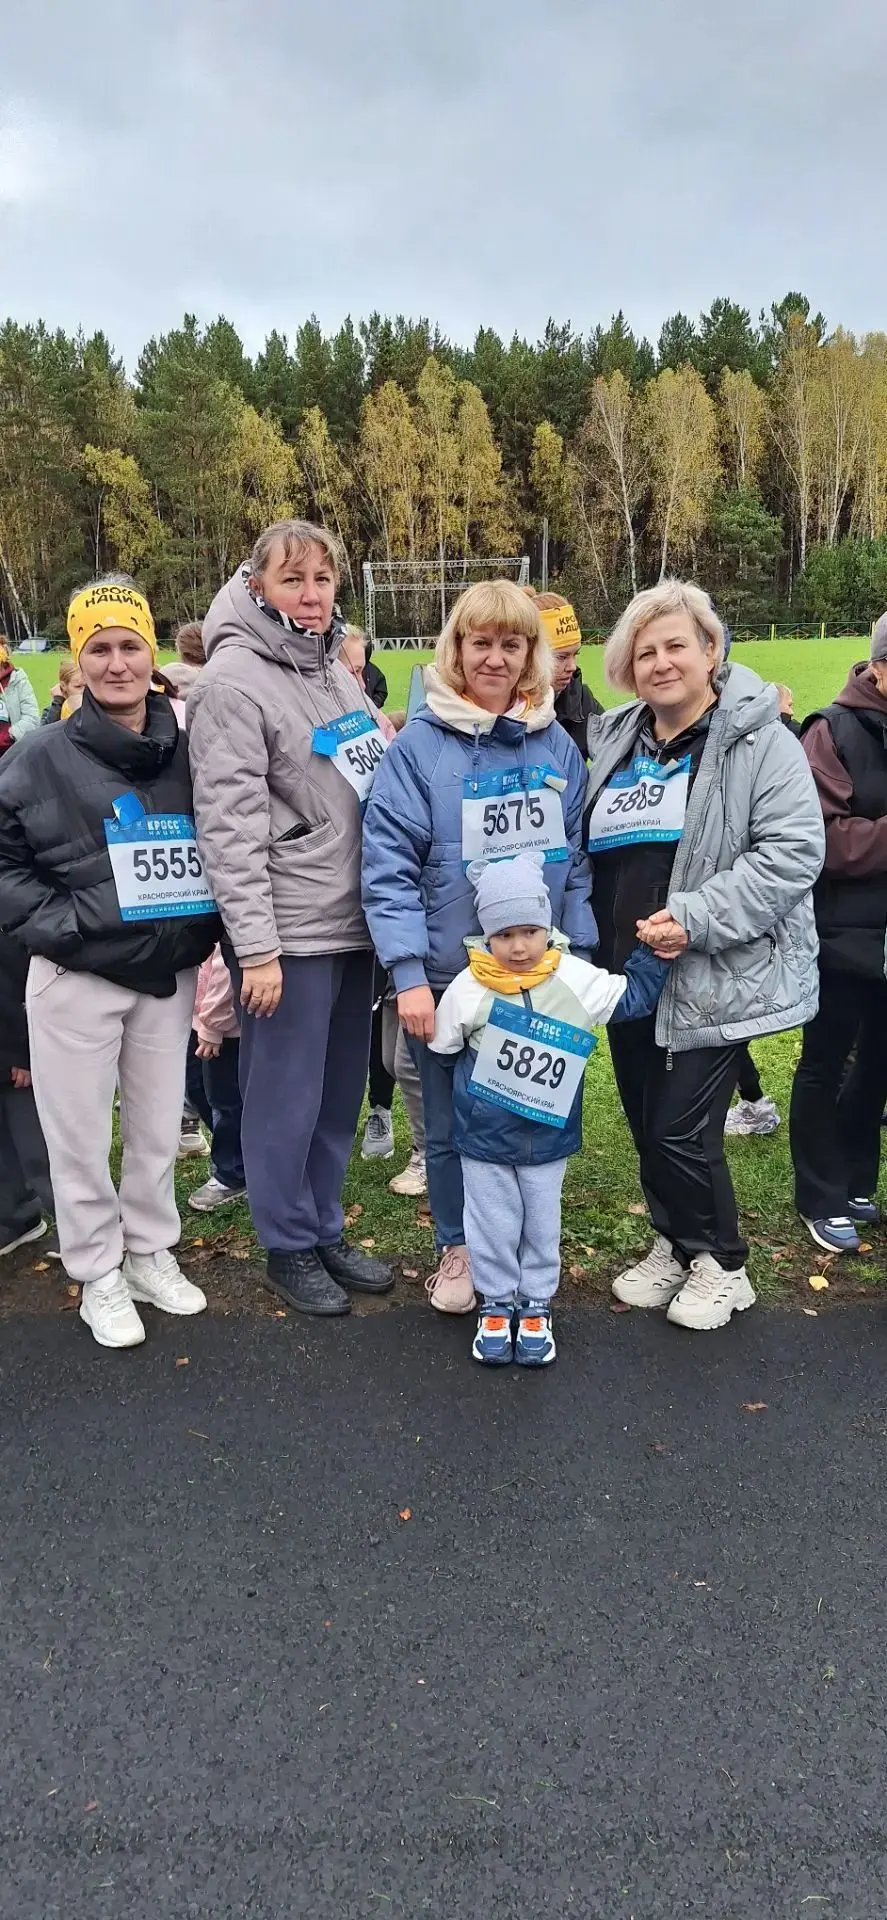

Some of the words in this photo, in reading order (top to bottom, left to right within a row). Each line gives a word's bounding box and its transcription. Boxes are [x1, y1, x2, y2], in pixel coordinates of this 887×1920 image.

[92, 587, 133, 597] КРОСС
[85, 594, 143, 611] НАЦИИ
[345, 738, 385, 776] 5649
[607, 782, 666, 815] 5889
[147, 820, 180, 831] КРОСС
[483, 796, 545, 836] 5675
[642, 818, 661, 827] КРАЙ
[482, 841, 534, 855] КРАСНОЯРСКИЙ
[534, 838, 550, 847] КРАЙ
[133, 847, 202, 882] 5555
[137, 888, 192, 901] КРАСНОЯРСКИЙ
[192, 887, 209, 897] КРАЙ
[530, 1018, 562, 1037] КРОСС
[496, 1038, 566, 1090] 5829
[487, 1078, 541, 1105] КРАСНОЯРСКИЙ
[540, 1100, 555, 1111] КРАЙ
